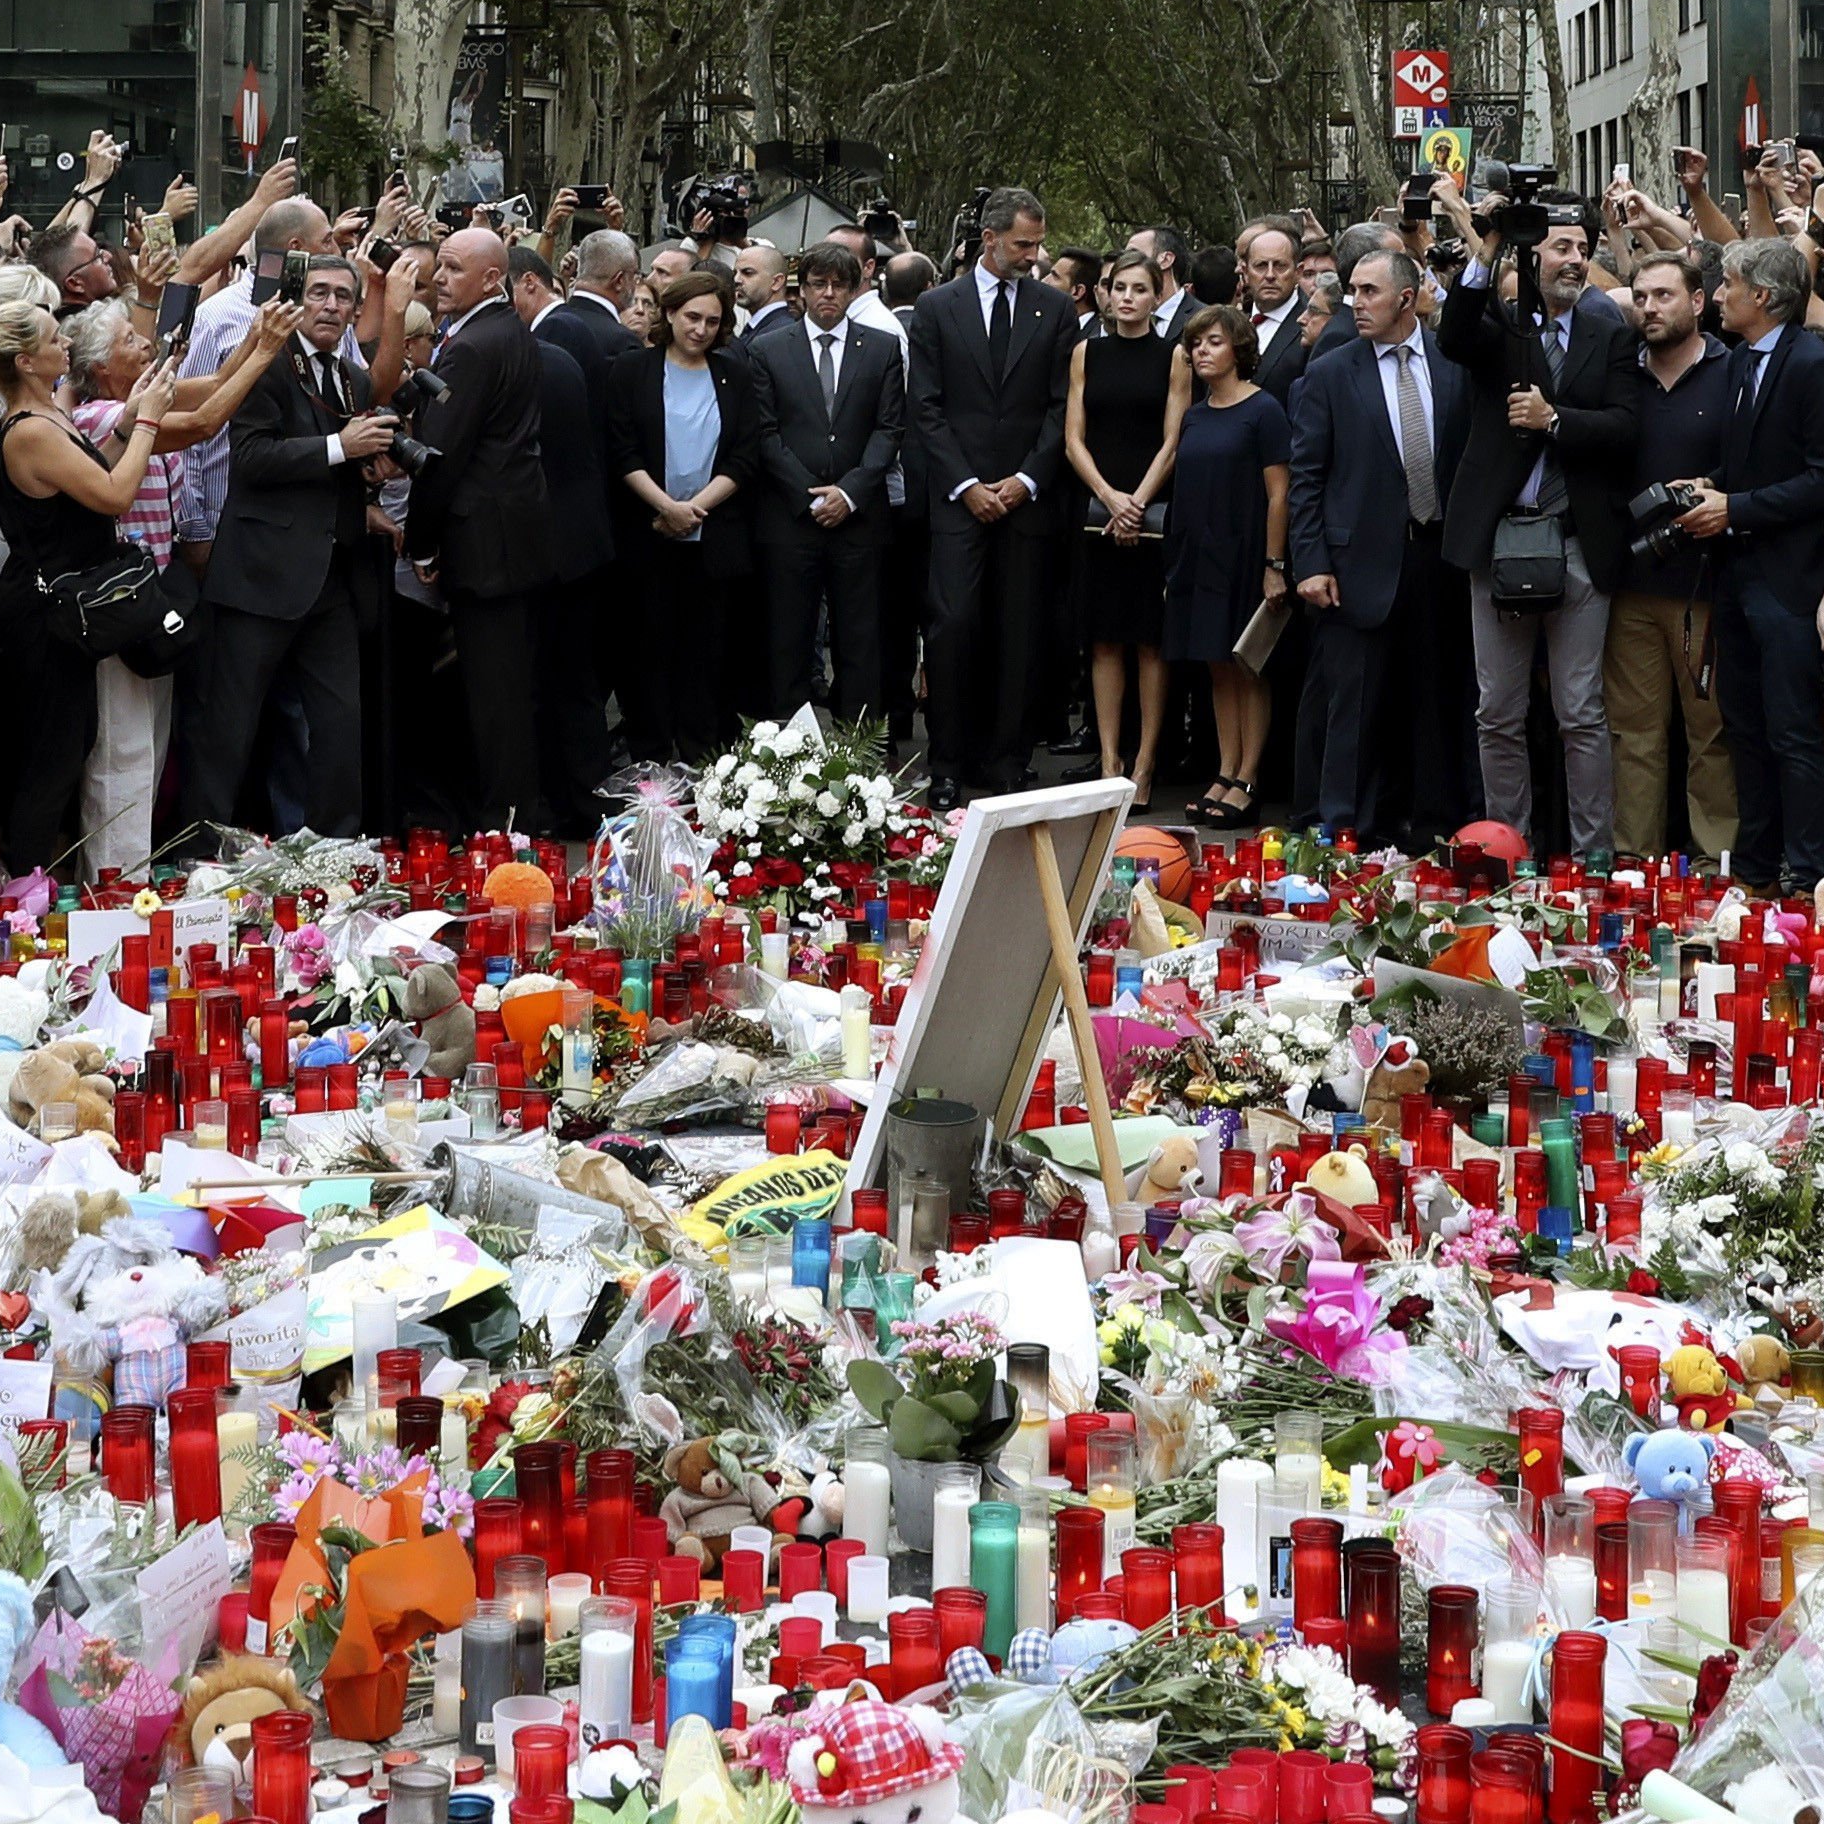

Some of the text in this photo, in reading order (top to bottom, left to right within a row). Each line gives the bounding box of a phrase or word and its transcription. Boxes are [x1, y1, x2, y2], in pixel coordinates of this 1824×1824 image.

[1412, 65, 1431, 83] M
[243, 89, 258, 146] M
[798, 1166, 835, 1191] DE
[227, 1325, 300, 1347] favorita
[246, 1351, 281, 1367] STYLE
[0, 1414, 34, 1432] qu
